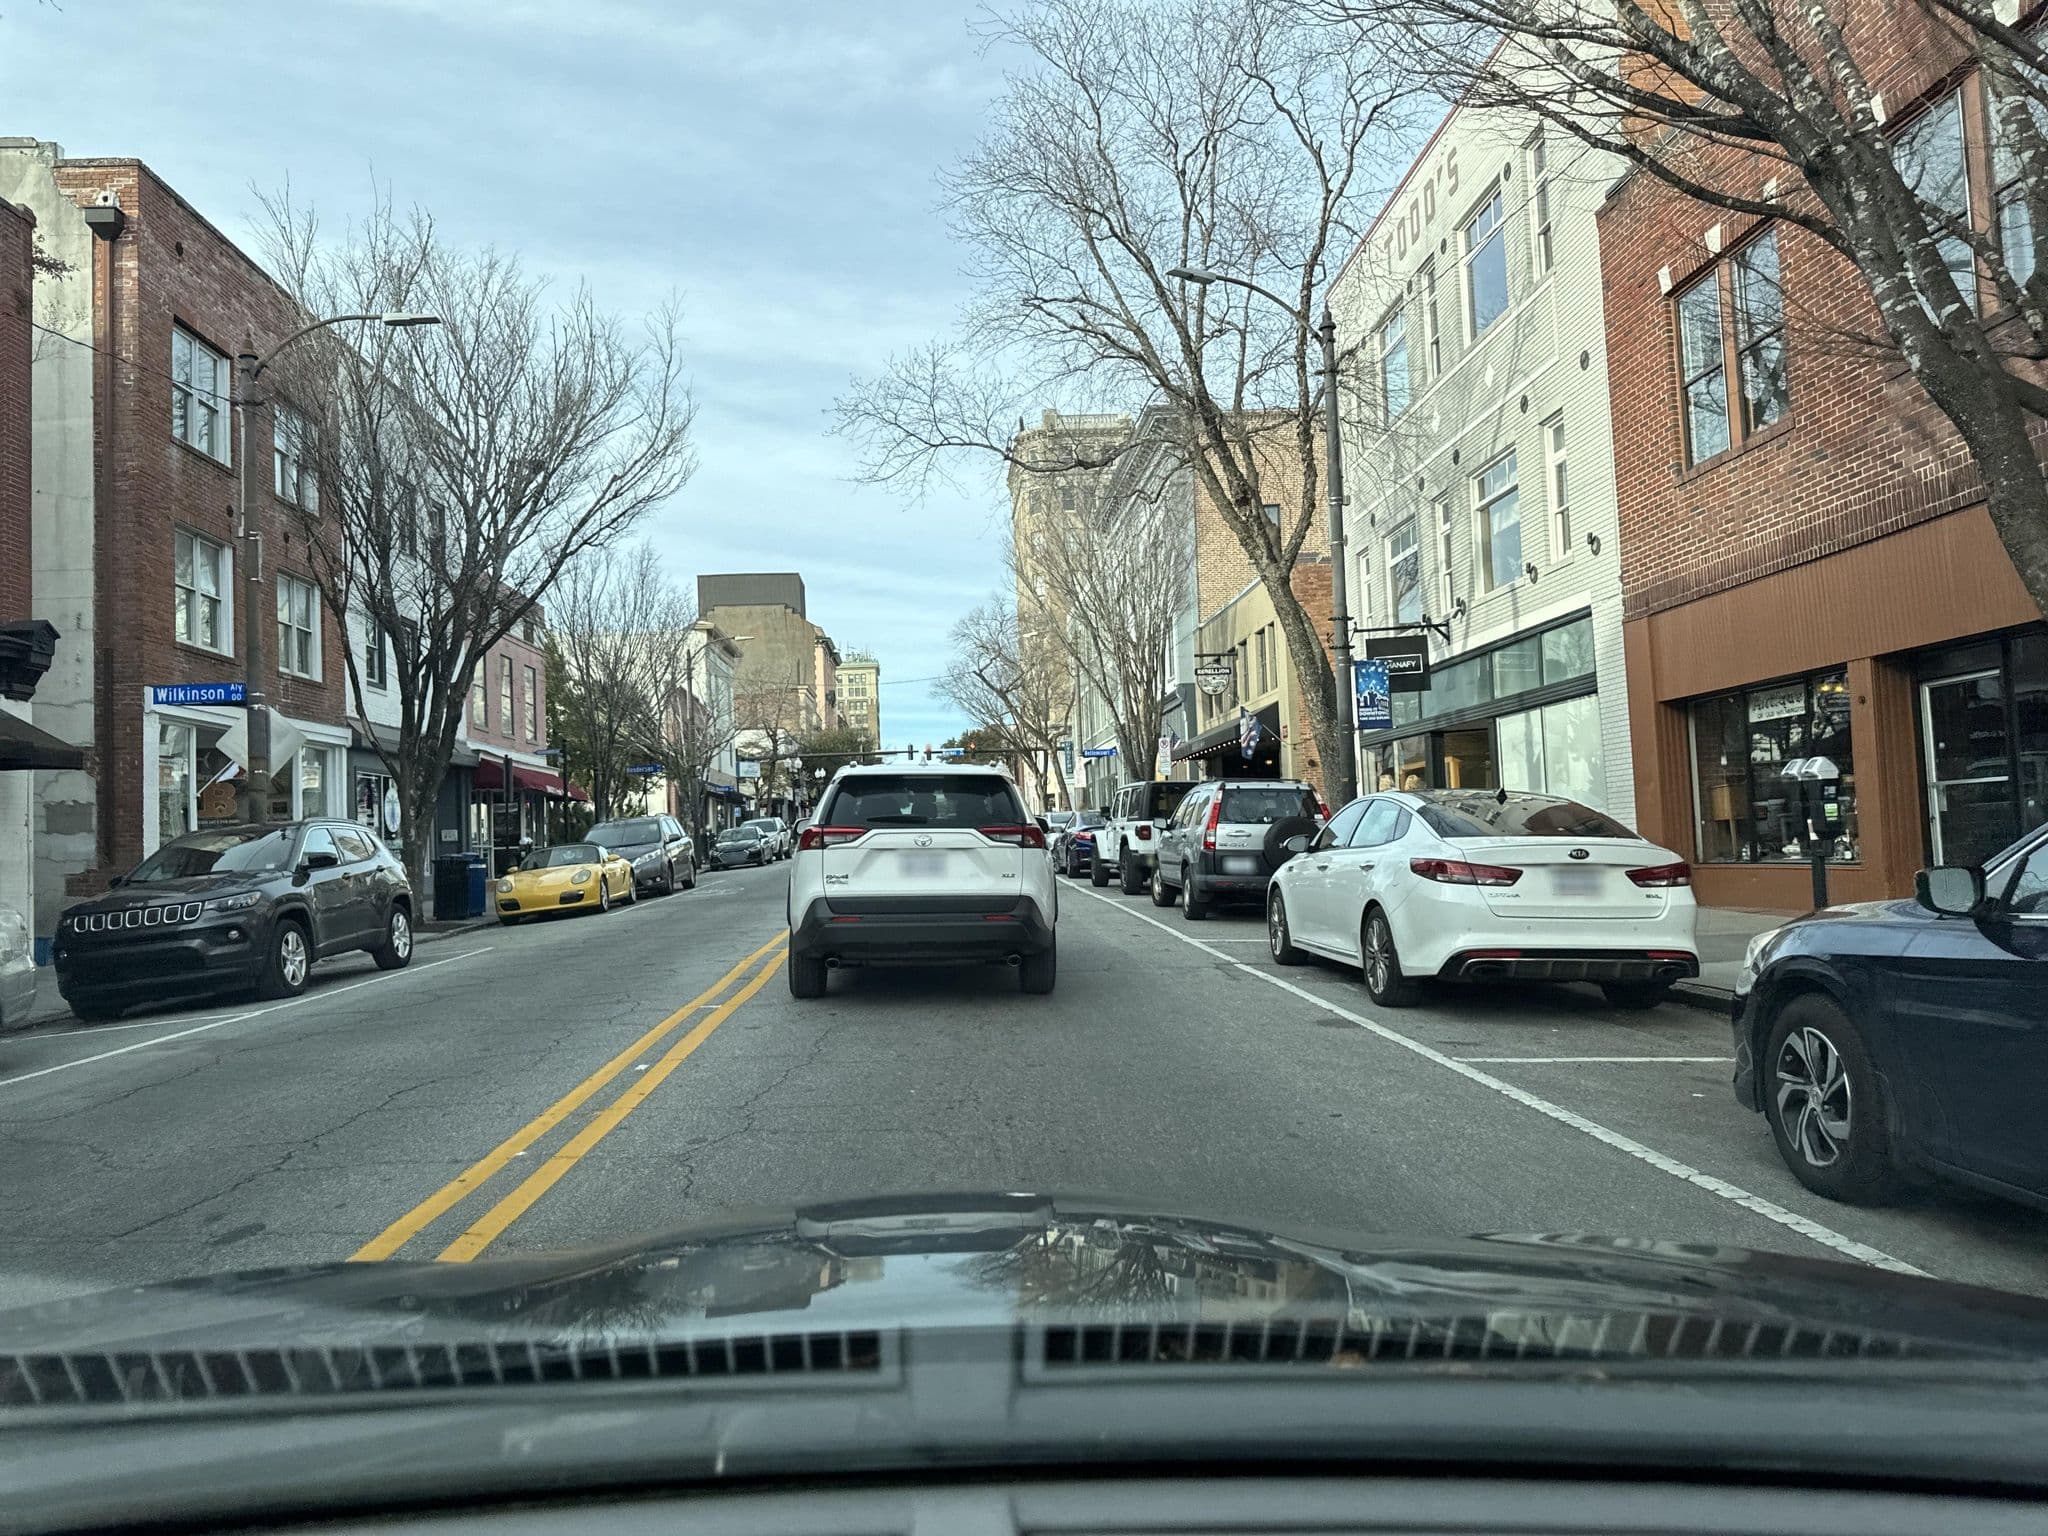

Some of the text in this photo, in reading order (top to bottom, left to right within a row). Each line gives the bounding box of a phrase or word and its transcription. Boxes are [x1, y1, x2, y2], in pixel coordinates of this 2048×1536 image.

[1384, 147, 1459, 274] TODD'S
[157, 683, 243, 701] Wilkinson Aly
